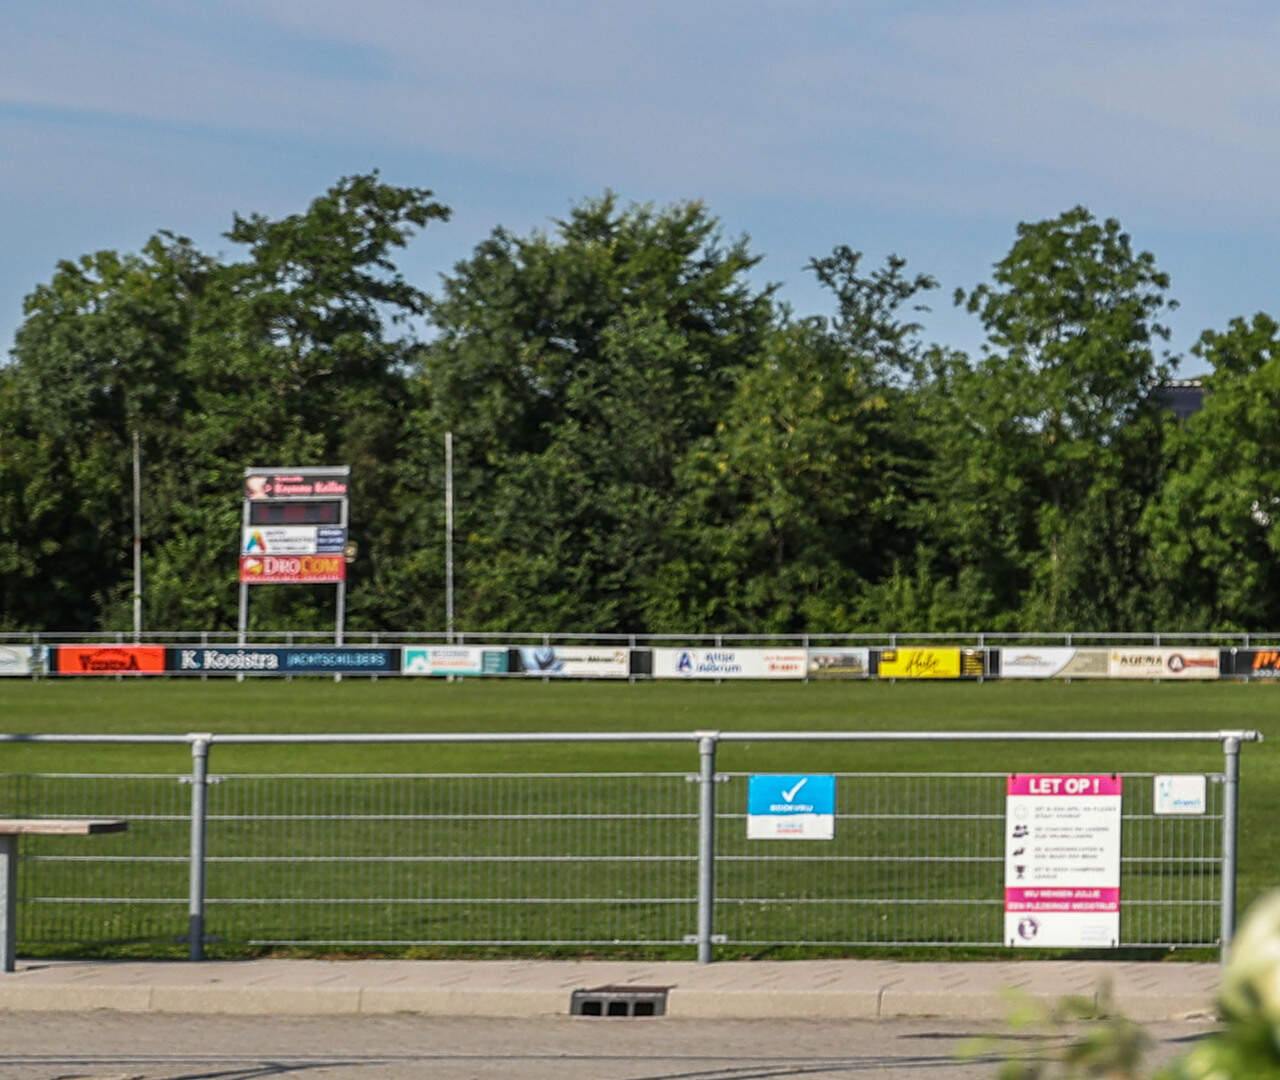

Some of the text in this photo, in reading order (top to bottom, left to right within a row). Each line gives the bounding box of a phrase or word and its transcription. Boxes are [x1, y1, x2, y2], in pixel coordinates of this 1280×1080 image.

[203, 650, 279, 669] Kooistra
[1029, 778, 1062, 794] LET
[1064, 778, 1091, 794] OP
